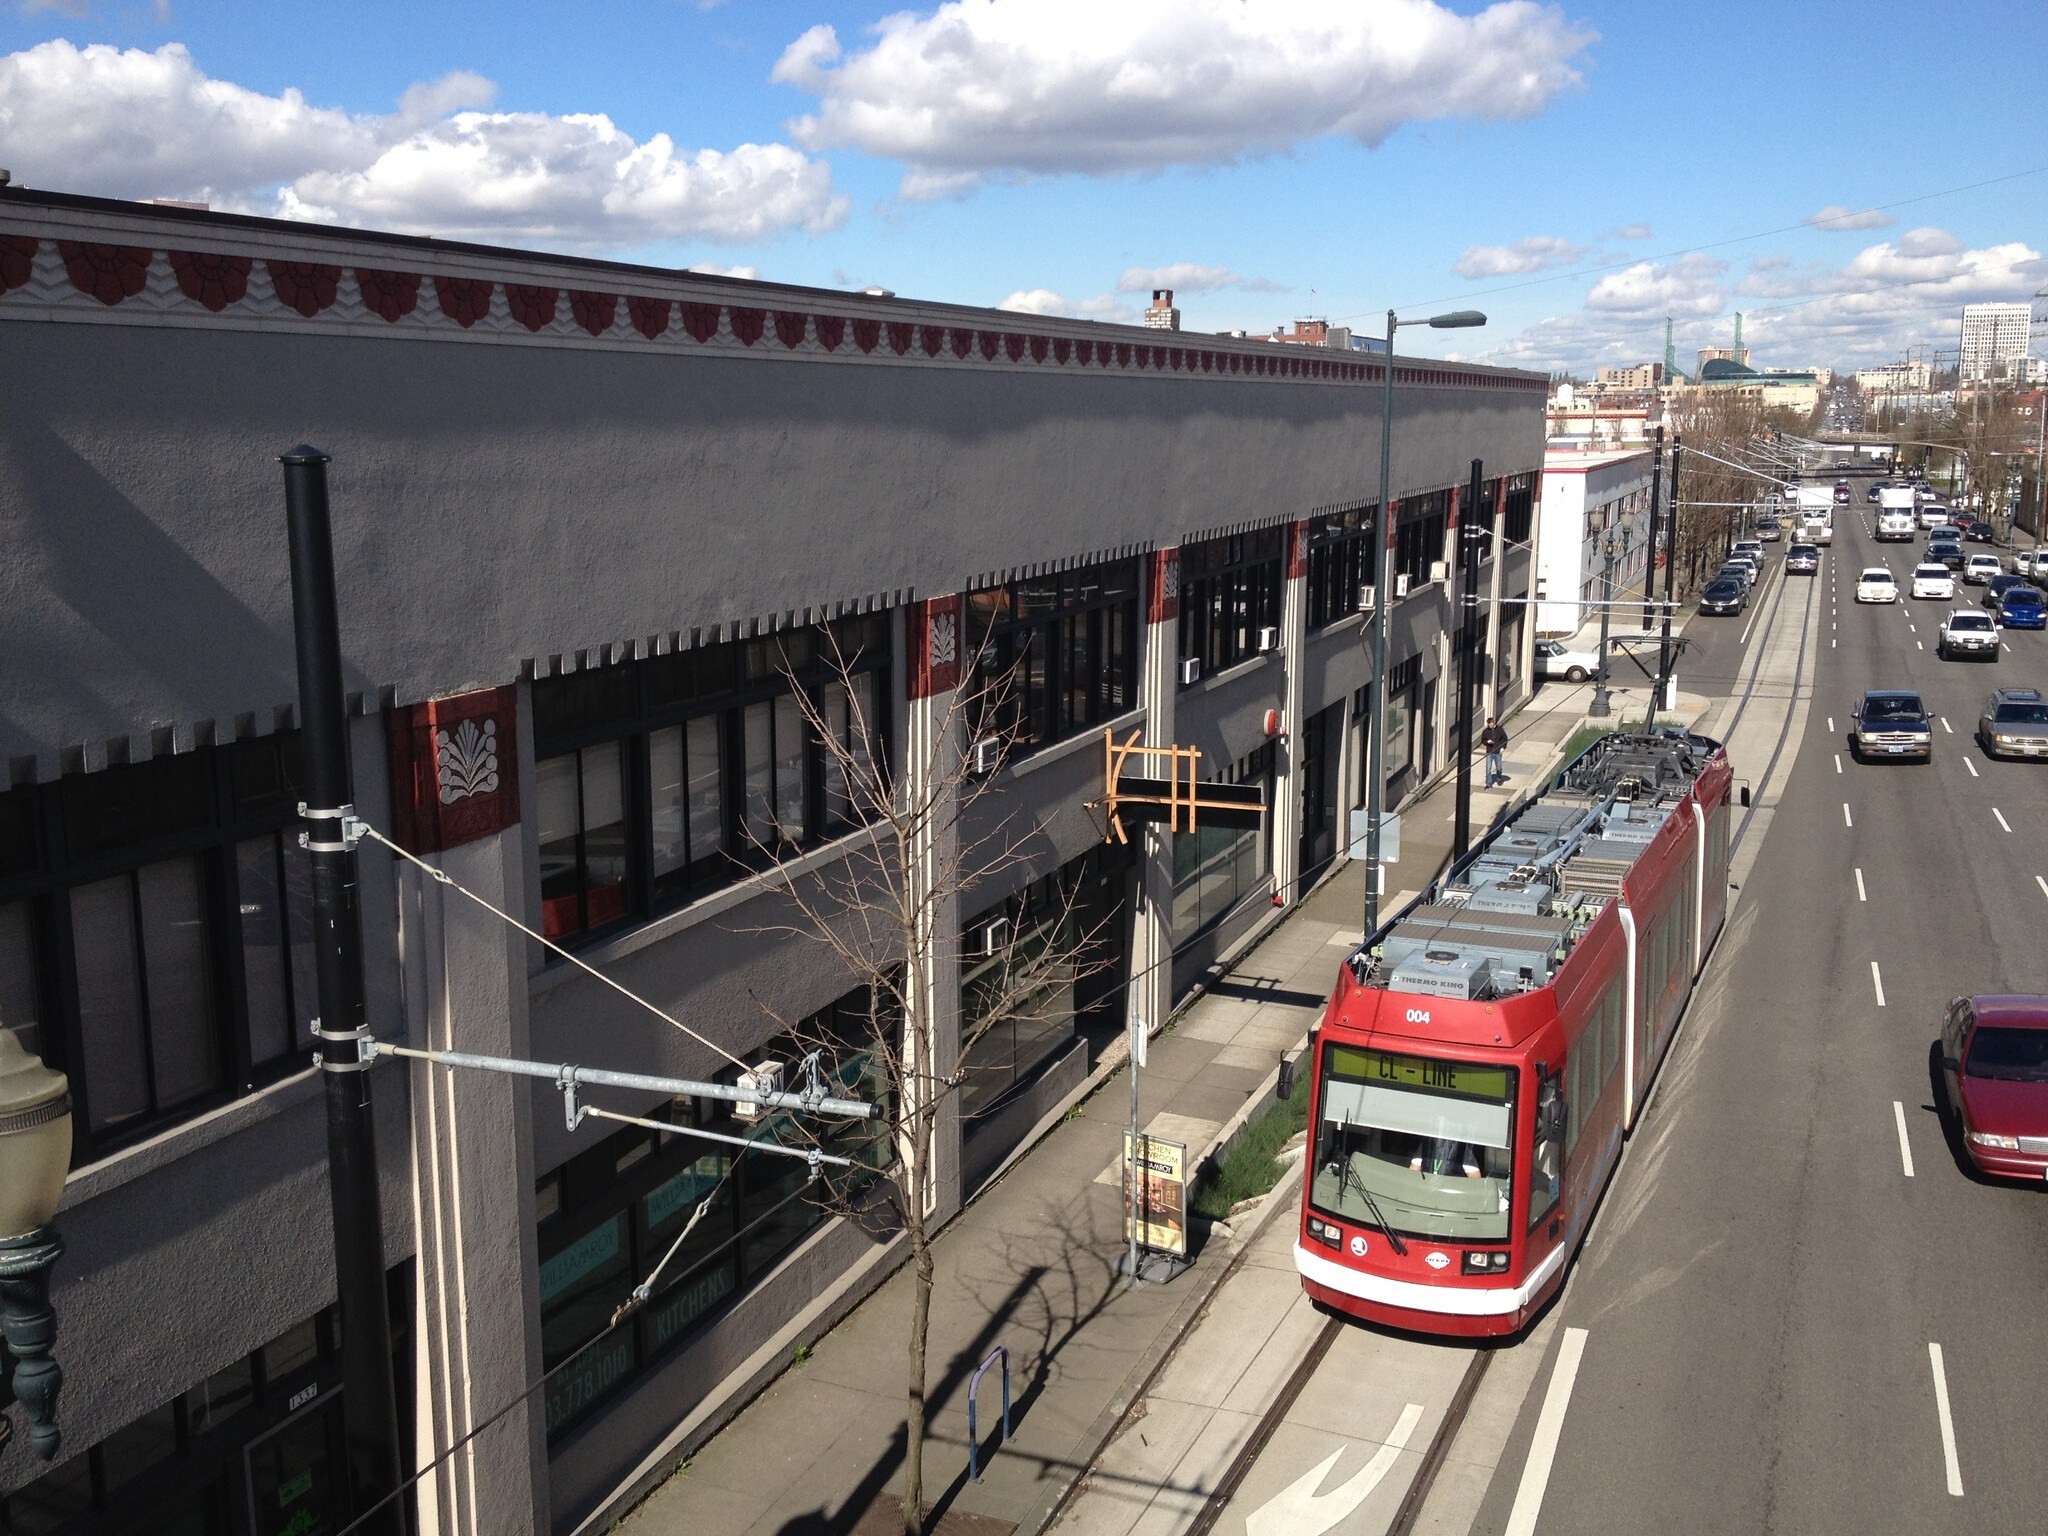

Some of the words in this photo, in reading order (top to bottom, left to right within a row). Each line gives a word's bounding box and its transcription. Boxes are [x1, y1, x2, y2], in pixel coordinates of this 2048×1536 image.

[1401, 976, 1438, 986] THERMO
[1439, 981, 1464, 990] KING
[1406, 1008, 1431, 1024] 004
[1379, 1055, 1398, 1080] CL
[1423, 1061, 1457, 1089] LINE
[656, 1266, 725, 1343] KITCHENS
[291, 1385, 317, 1409] 1337
